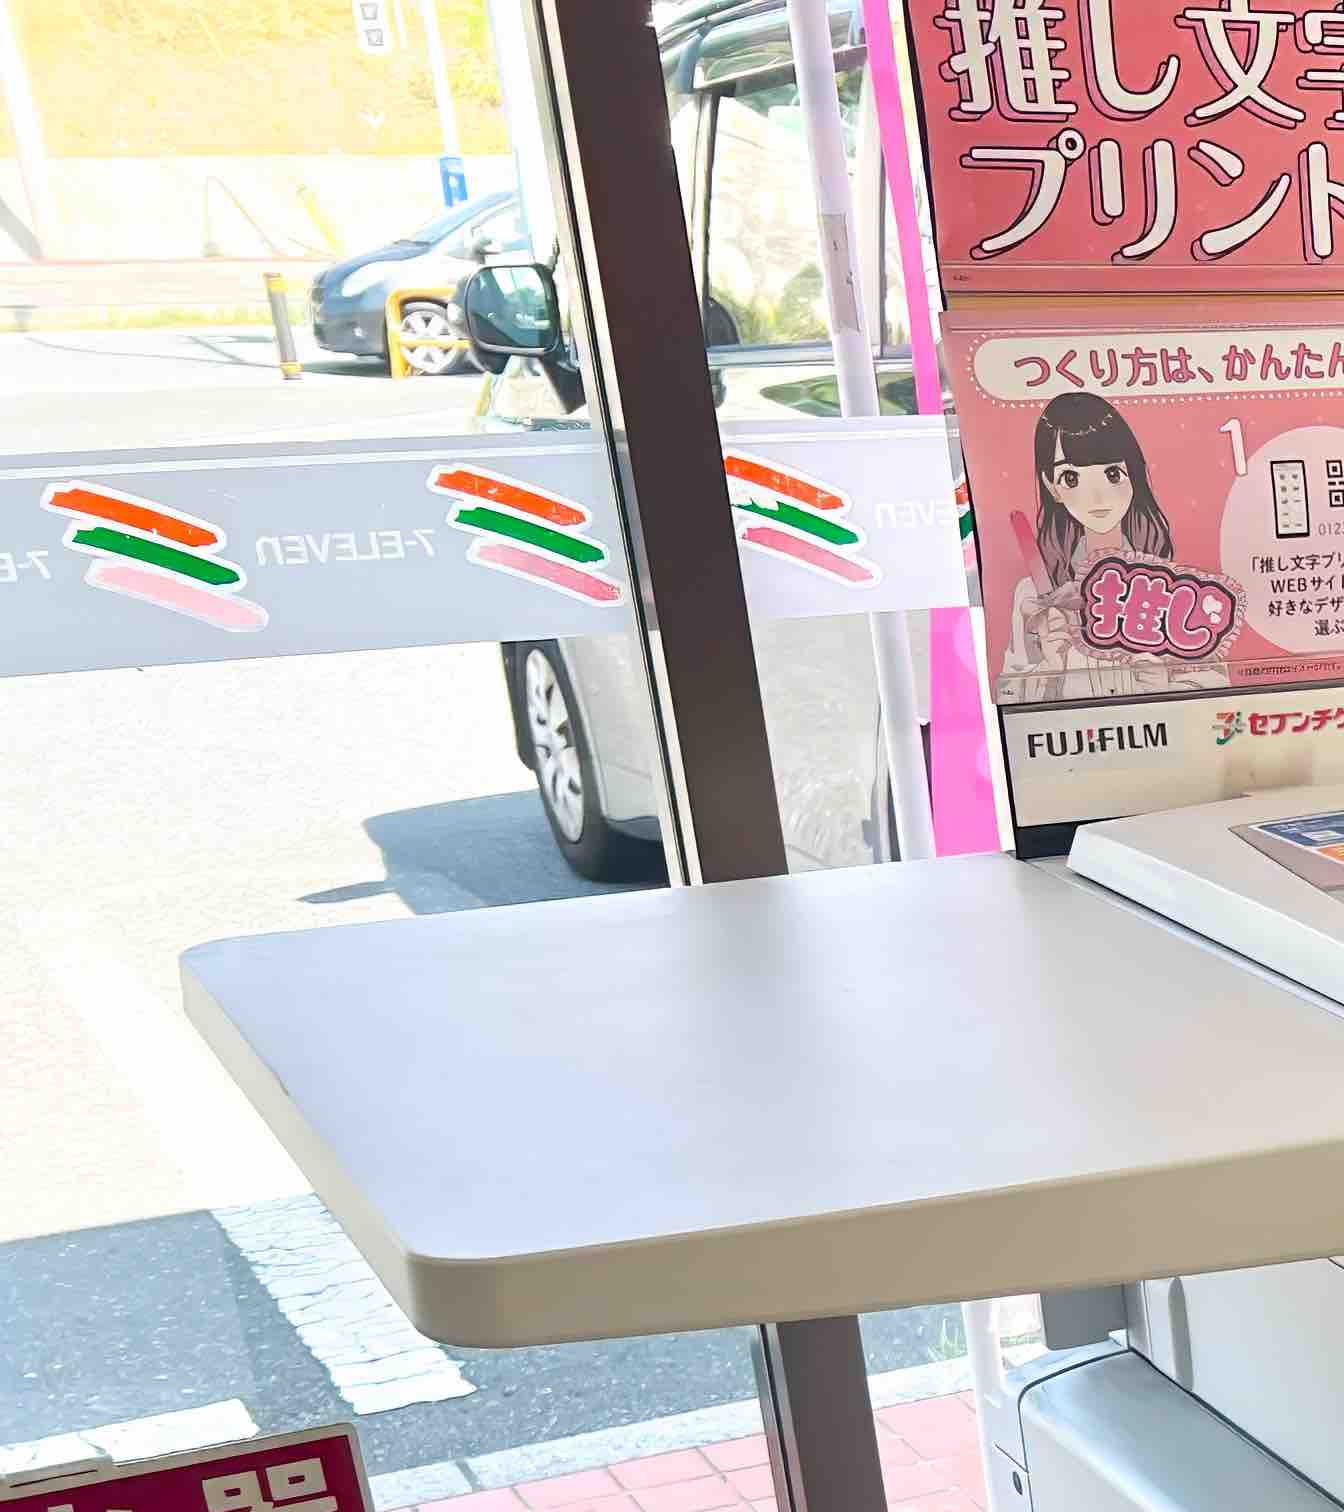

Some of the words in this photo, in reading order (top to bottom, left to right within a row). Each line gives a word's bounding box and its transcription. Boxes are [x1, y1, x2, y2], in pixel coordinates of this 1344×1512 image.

[1219, 417, 1248, 477] 1
[1090, 566, 1226, 650] 推し
[1315, 618, 1344, 637] 選ぶ
[1027, 722, 1168, 759] FUJIFILM
